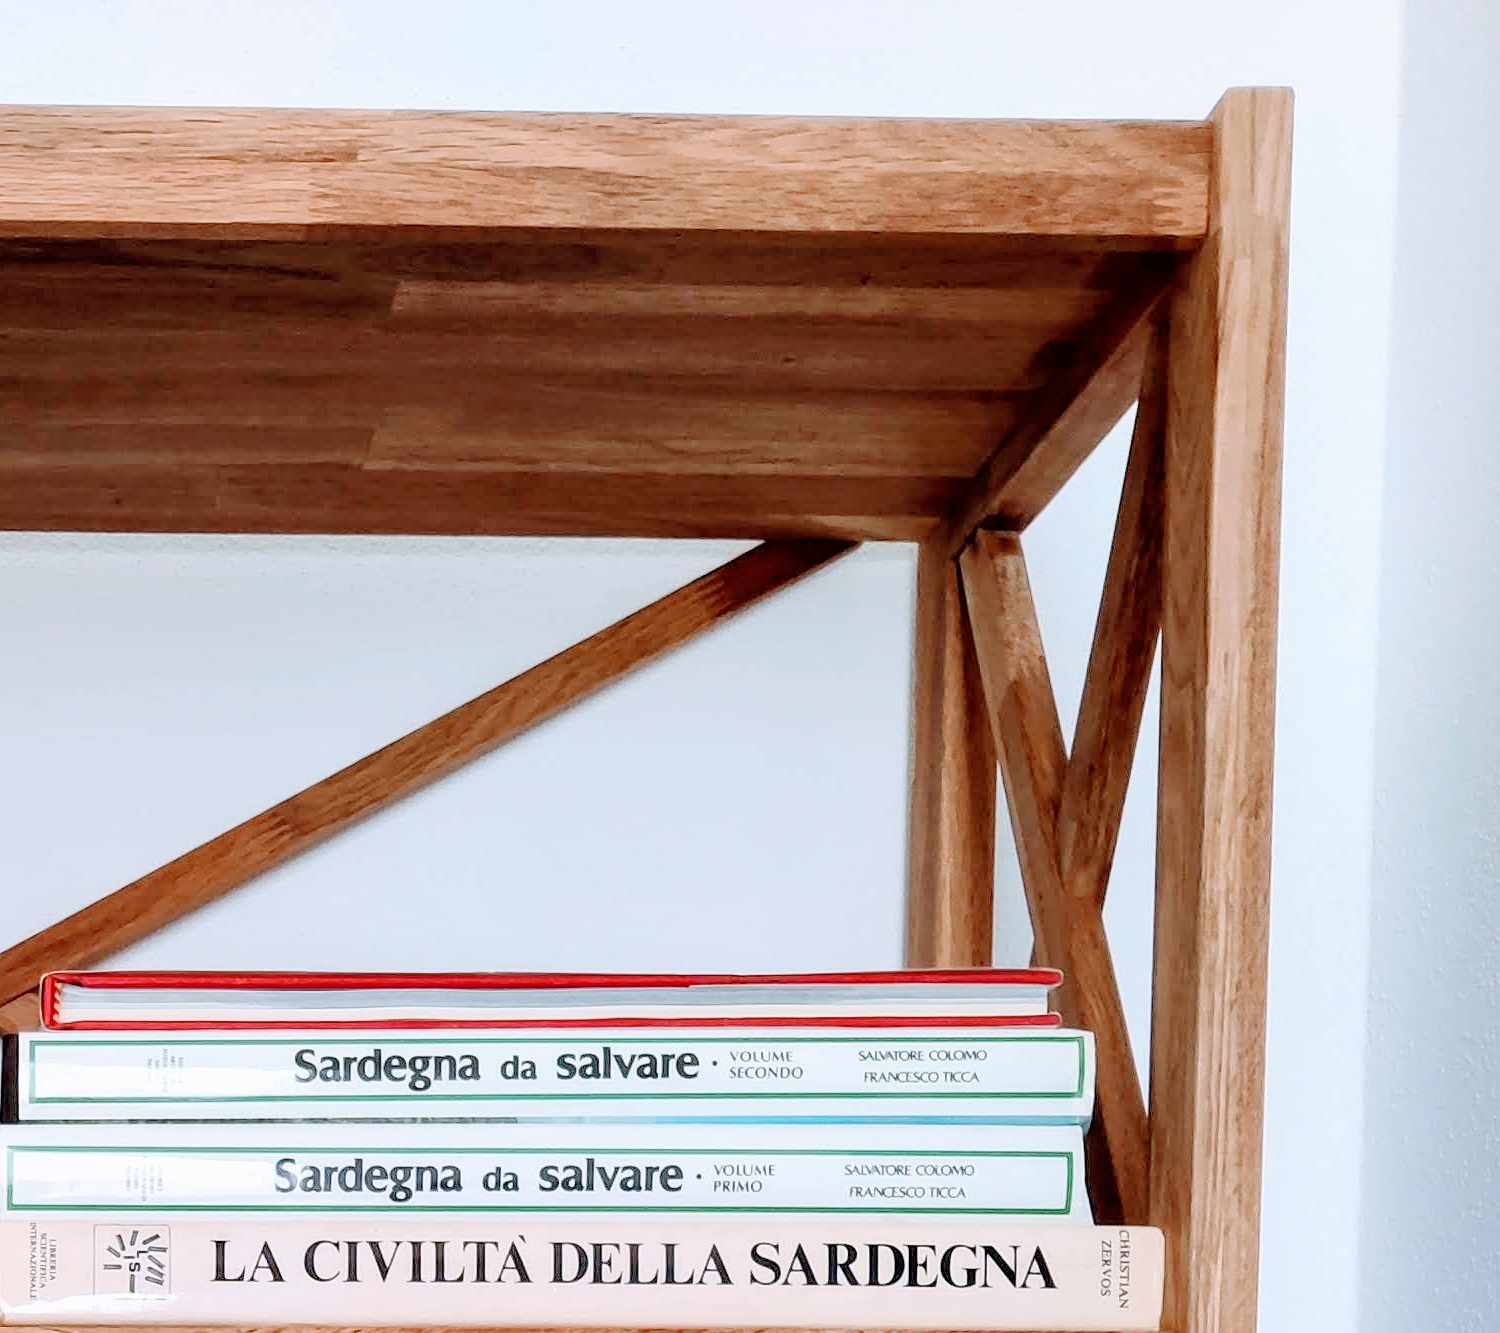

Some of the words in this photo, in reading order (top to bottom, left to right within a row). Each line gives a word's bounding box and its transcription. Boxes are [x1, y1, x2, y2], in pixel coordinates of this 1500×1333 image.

[729, 1051, 794, 1063] VOLUME
[858, 1050, 926, 1062] SALVATORE
[929, 1050, 988, 1062] COLOMO
[293, 1047, 481, 1091] Sardegna
[500, 1054, 538, 1080] da
[556, 1046, 699, 1080] salvare
[729, 1066, 804, 1080] SECONDO
[864, 1071, 939, 1084] FRANCESCO
[713, 1164, 777, 1177] VOLUME
[844, 1164, 912, 1177] SALVATORE
[915, 1164, 975, 1177] COLOMO
[273, 1157, 462, 1201] Sardegna
[482, 1166, 519, 1192] da
[538, 1158, 683, 1193] salvare
[713, 1180, 763, 1194] PRIMO
[849, 1186, 926, 1199] FRANCESCO
[210, 1239, 285, 1283] LA
[302, 1234, 533, 1284] CIVILTÀ
[549, 1241, 734, 1286] DELLA
[749, 1242, 1058, 1290] SARDEGNA
[1100, 1240, 1113, 1297] ZERVOS
[1118, 1230, 1131, 1309] CHRISTIAN
